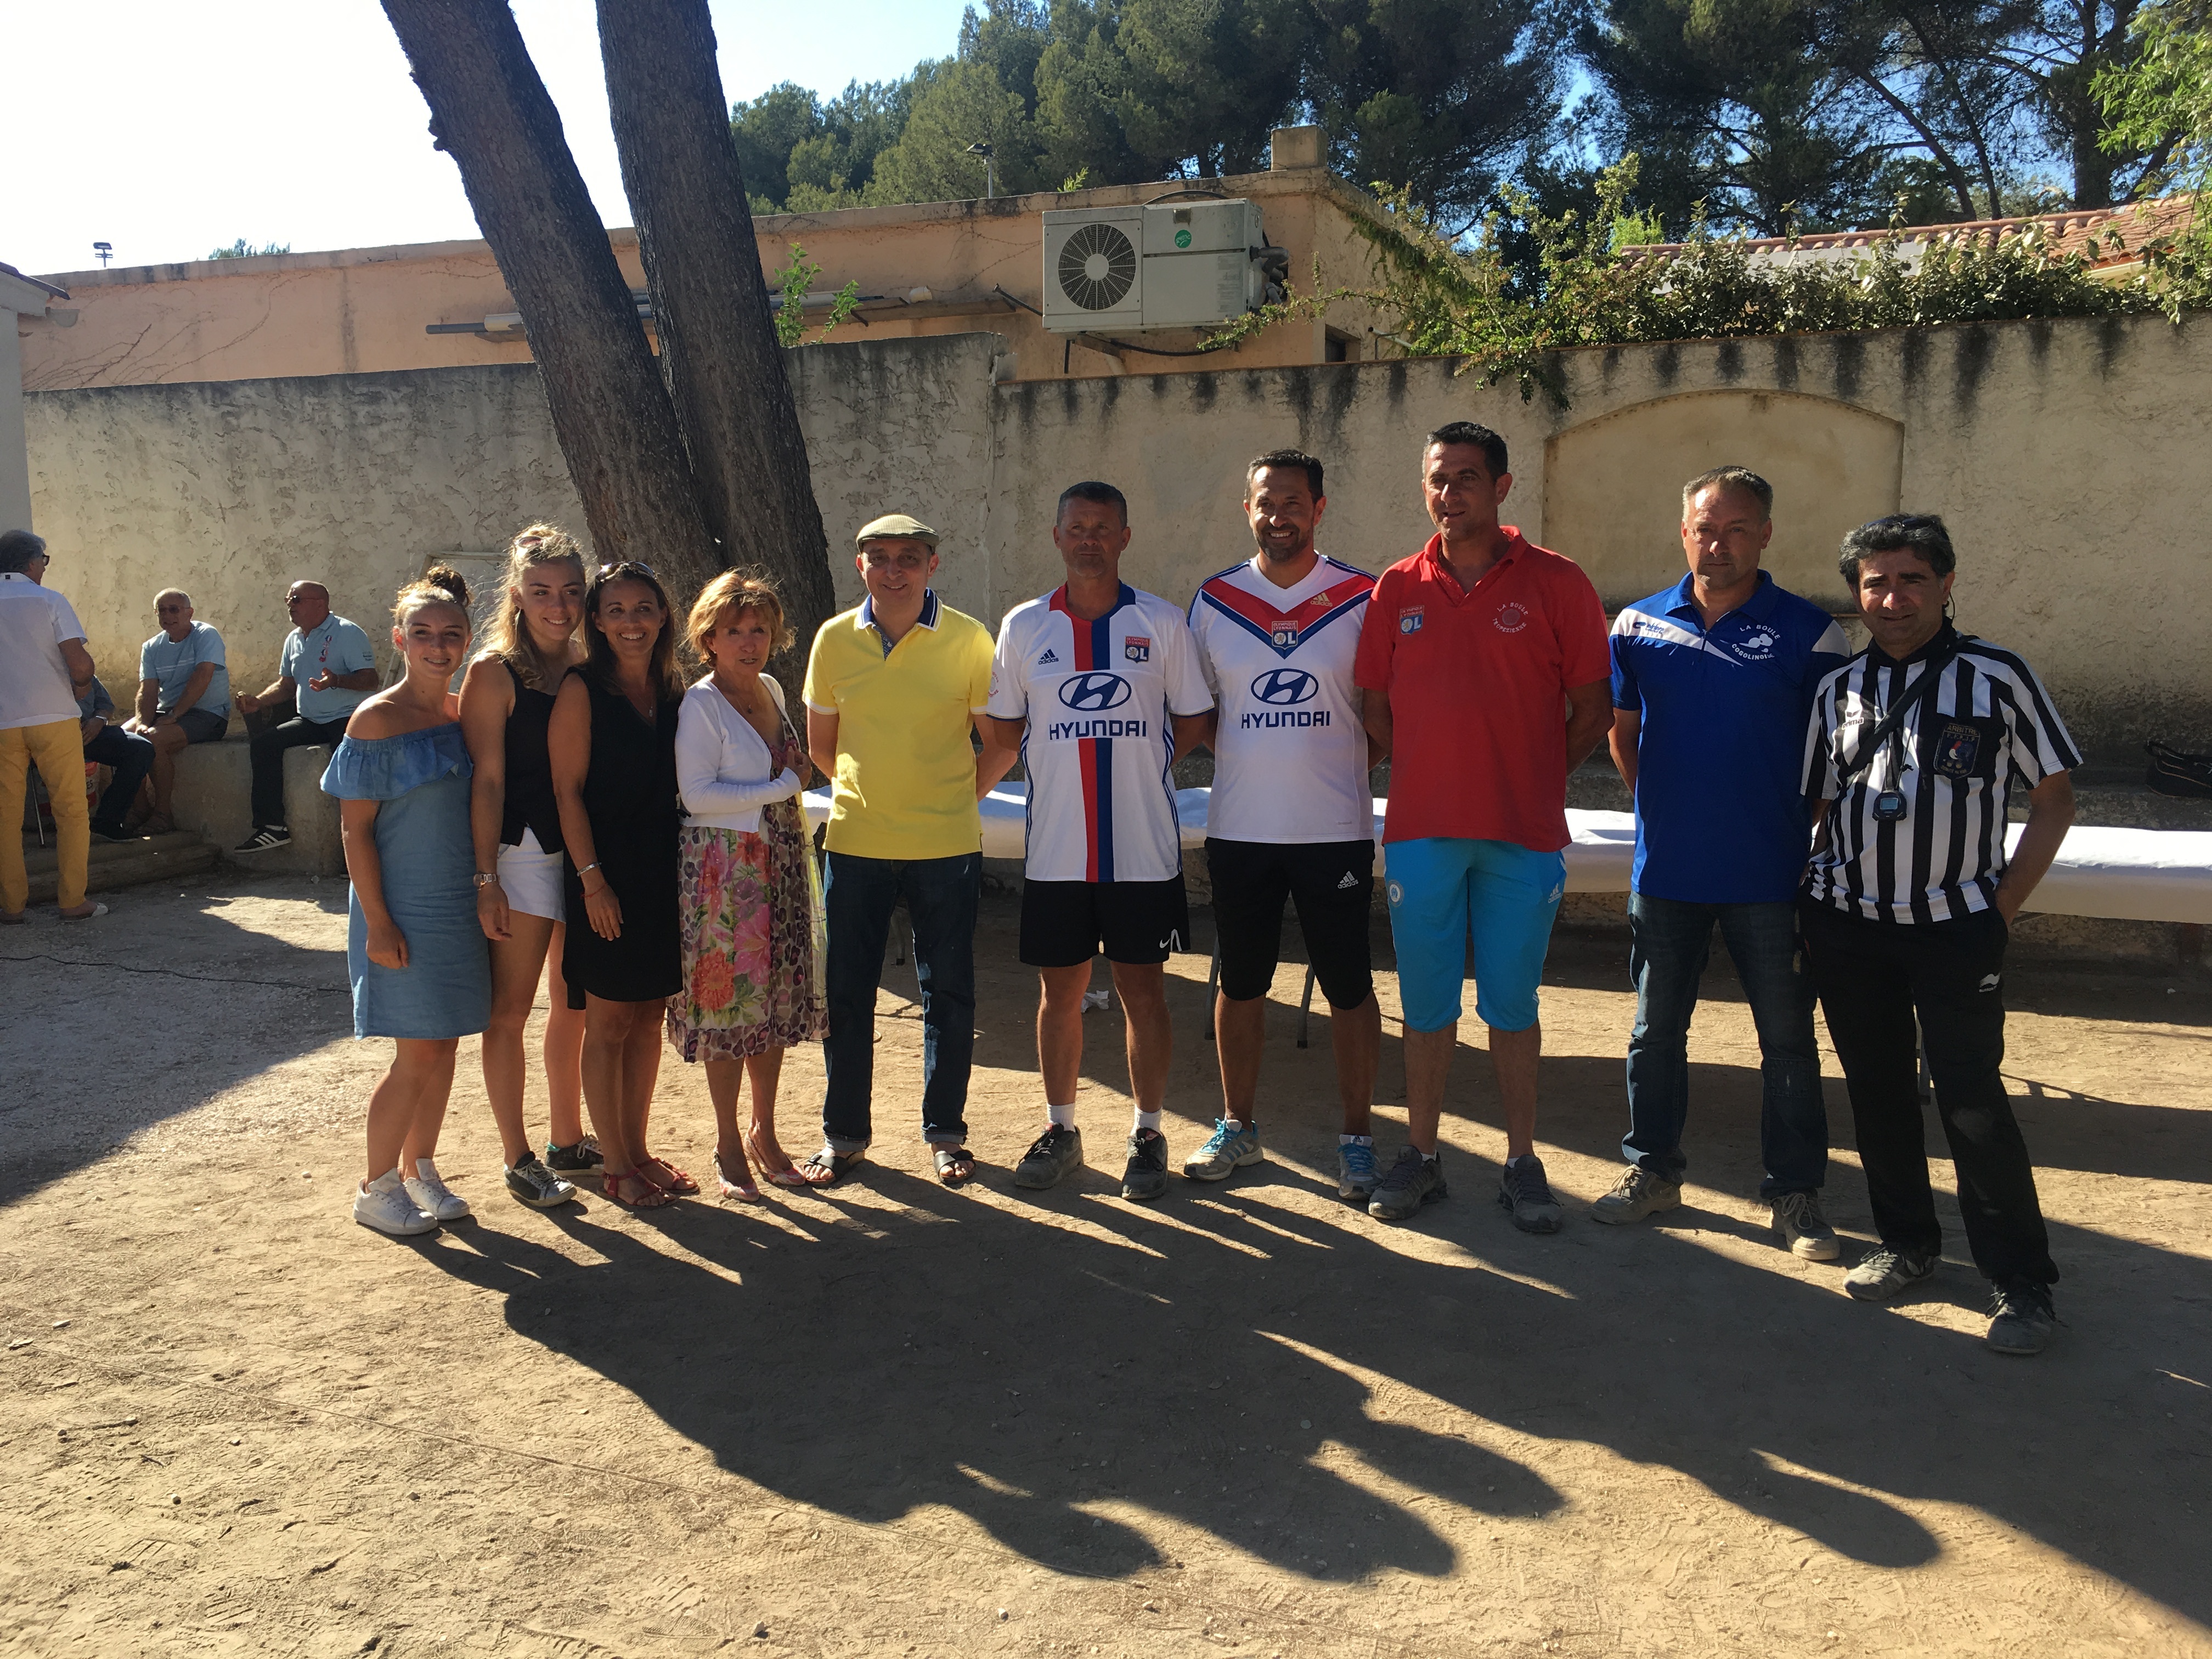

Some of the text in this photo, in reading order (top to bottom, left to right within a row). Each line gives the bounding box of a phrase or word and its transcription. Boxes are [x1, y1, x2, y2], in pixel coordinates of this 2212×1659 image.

[1497, 604, 1507, 612] LA
[1756, 624, 1781, 640] BOULE
[1241, 711, 1330, 729] HYUNDAI
[1049, 720, 1147, 741] HYUNDAI
[1947, 725, 1978, 736] ARBITRE
[1338, 879, 1359, 889] adidas
